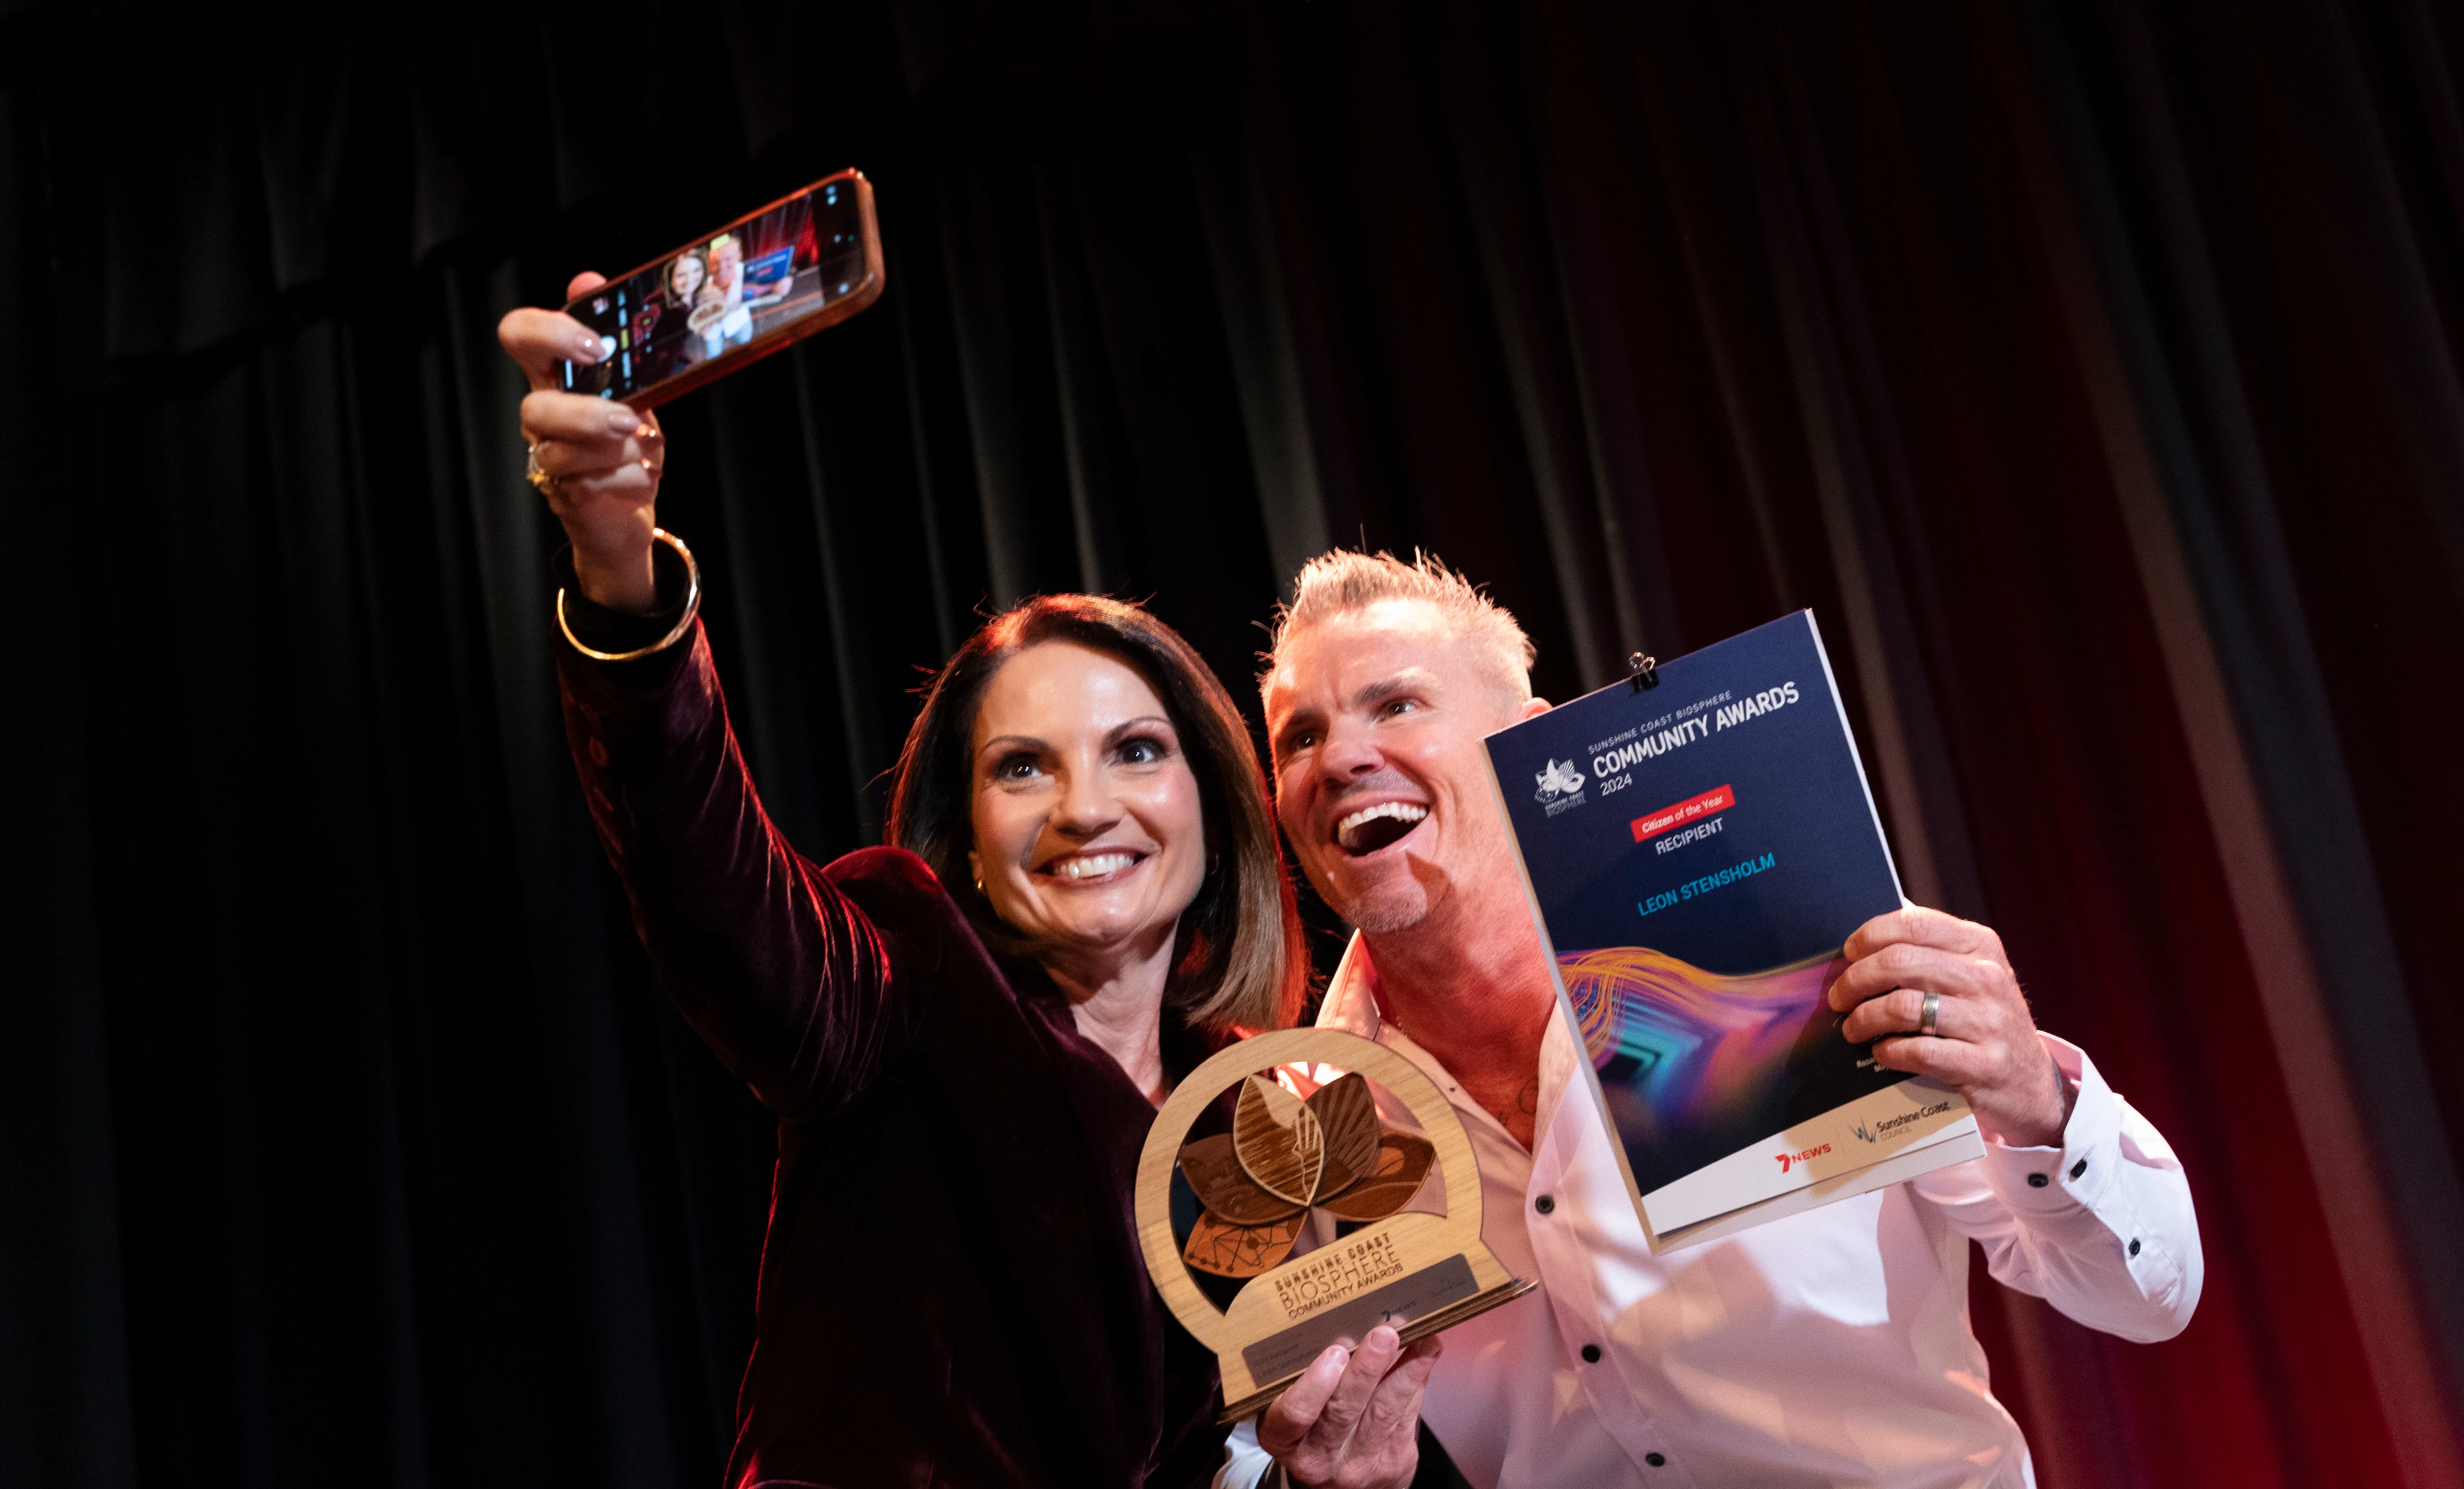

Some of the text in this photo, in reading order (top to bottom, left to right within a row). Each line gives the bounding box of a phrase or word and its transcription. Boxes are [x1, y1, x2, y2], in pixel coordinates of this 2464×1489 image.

[1588, 690, 1733, 755] SUNSHINE COAST BIOSPHERE
[1594, 681, 1800, 778] COMMUNITY AWARDS
[1600, 773, 1633, 796] 2024
[1642, 795, 1723, 833] Citizen of the Year
[1655, 817, 1723, 855] RECIPIENT
[1637, 852, 1776, 917] LEON STENSHOLM
[1877, 1101, 1950, 1132] Sunshine Coast
[1274, 1232, 1390, 1291] SUNSHINE COAST
[1279, 1244, 1400, 1311] BIOSPHERE
[1289, 1283, 1354, 1320] COMMUNITY
[1357, 1262, 1403, 1289] AWARDS
